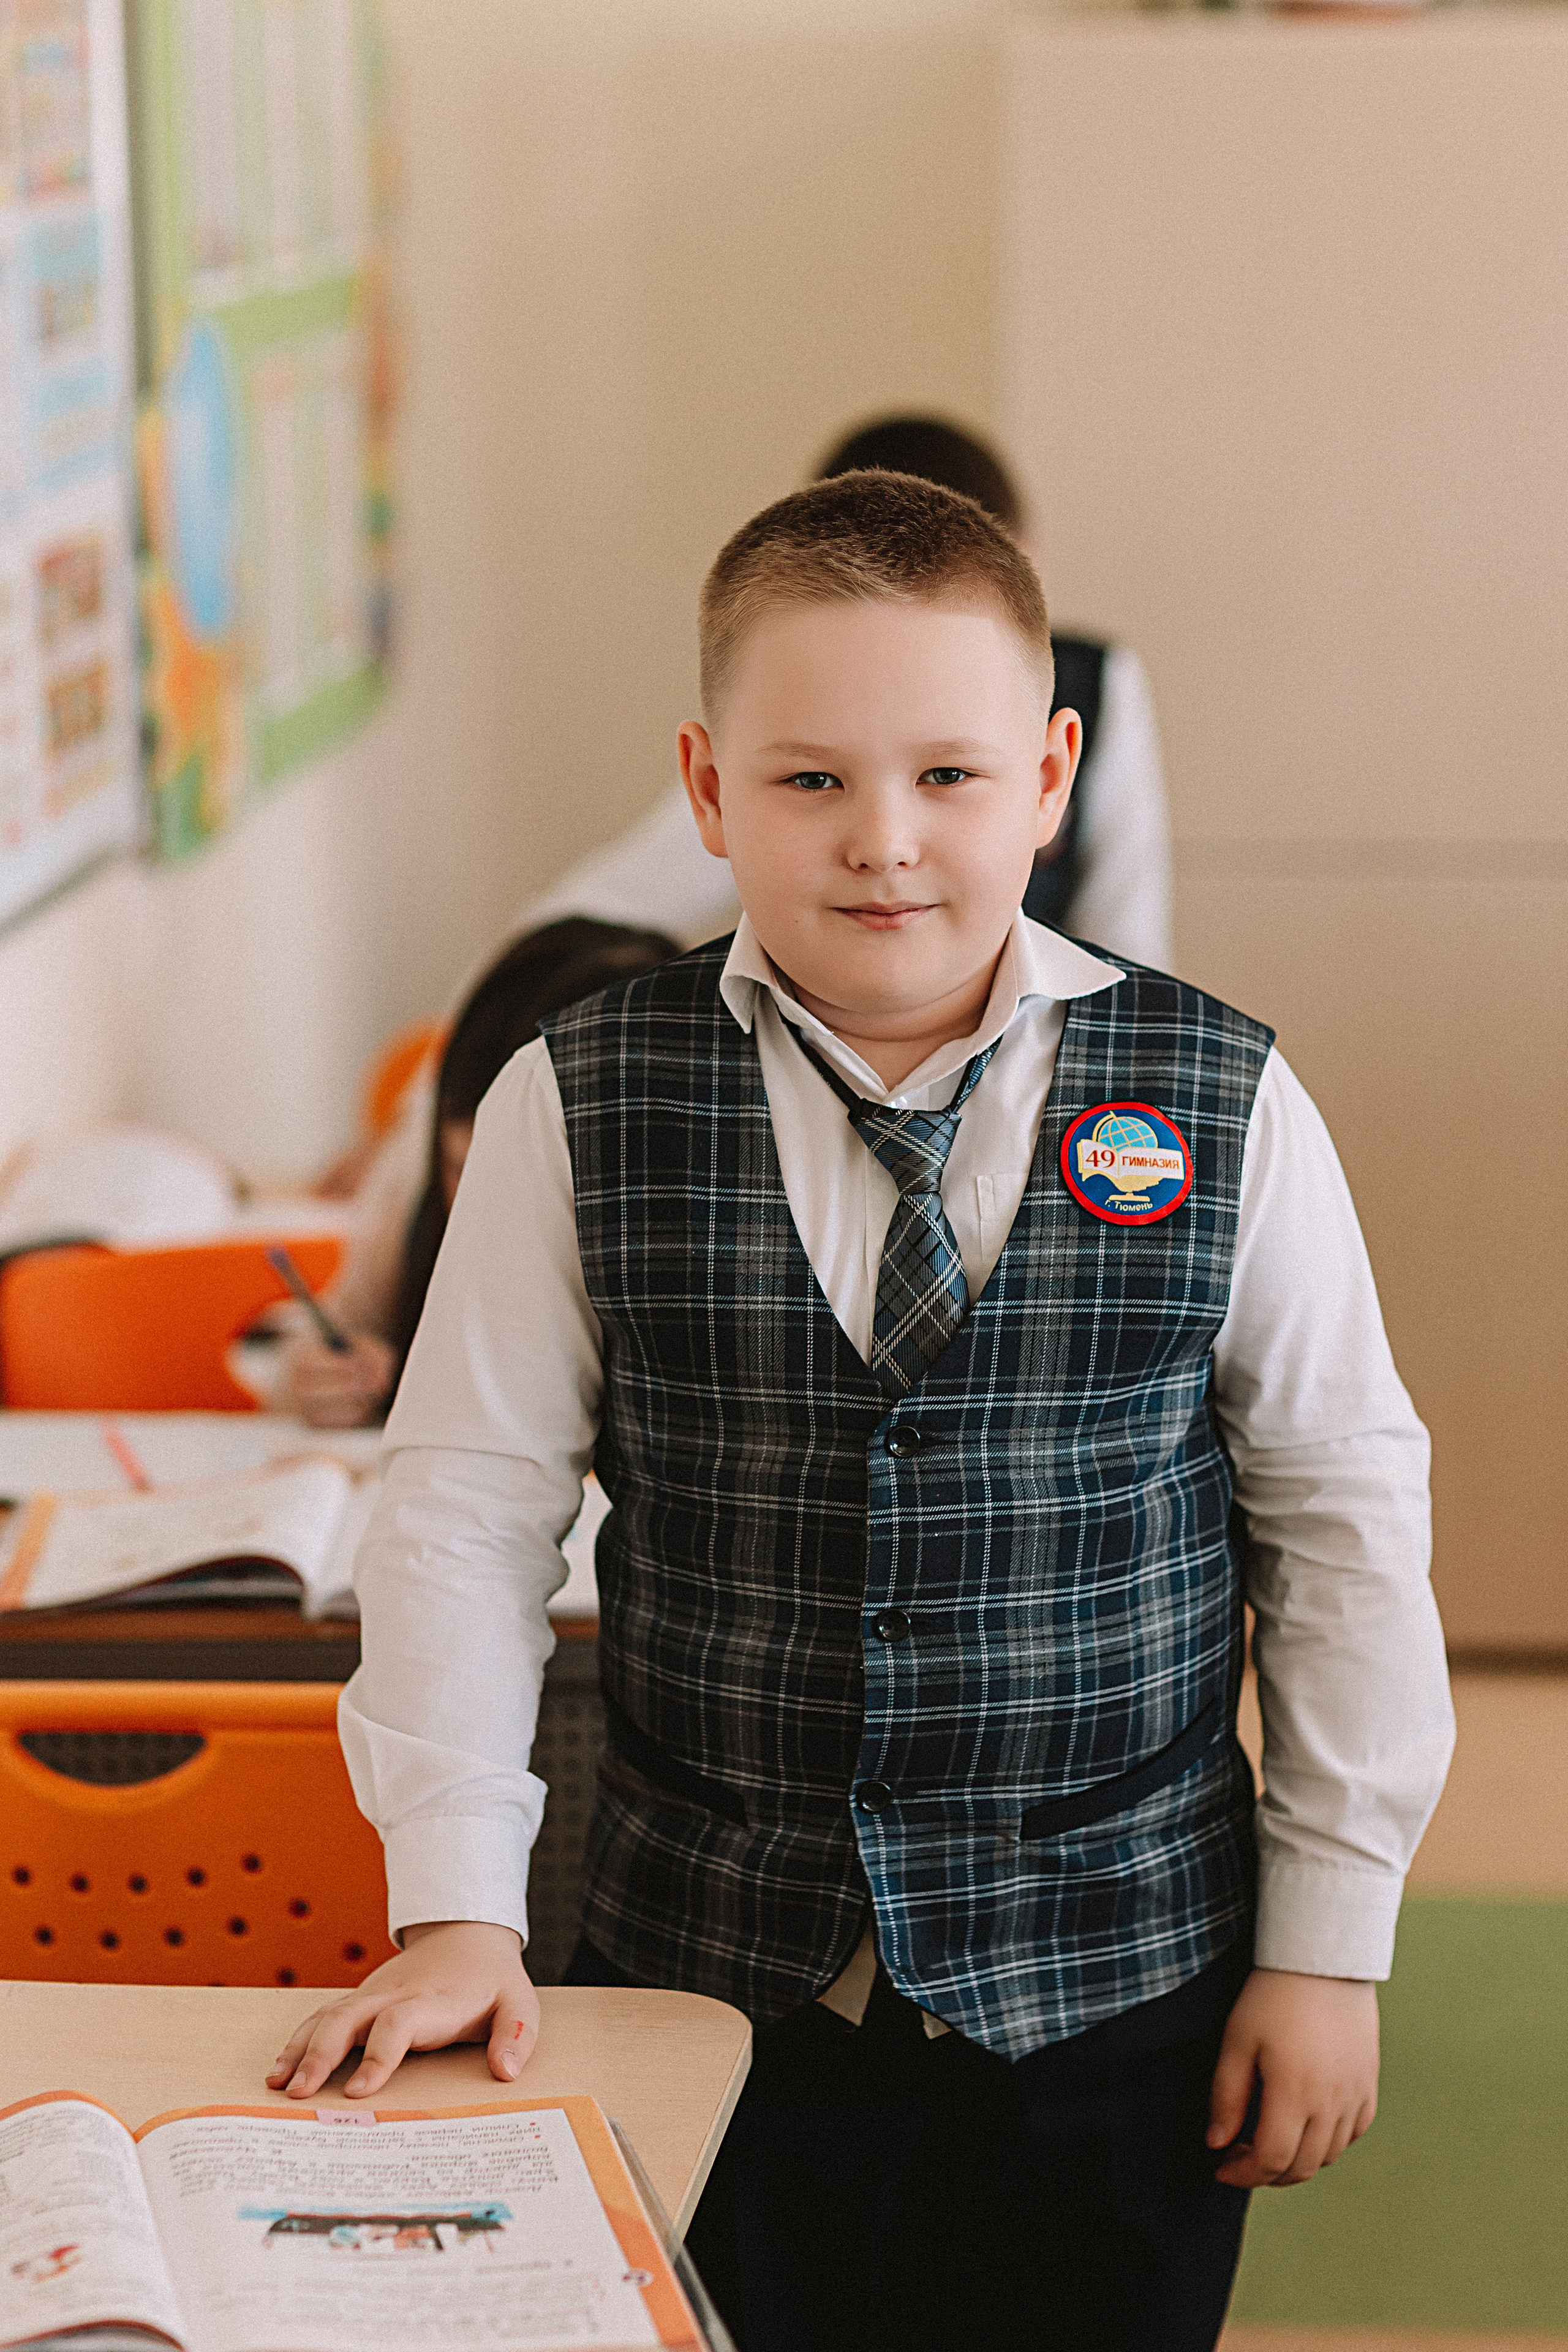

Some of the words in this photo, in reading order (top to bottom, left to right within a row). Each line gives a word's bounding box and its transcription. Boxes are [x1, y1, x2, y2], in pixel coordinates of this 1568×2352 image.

[1086, 1150, 1115, 1168] 49
[1121, 1156, 1180, 1170] ГИМНАЗИЯ
[1115, 1201, 1153, 1212] Тюмень
